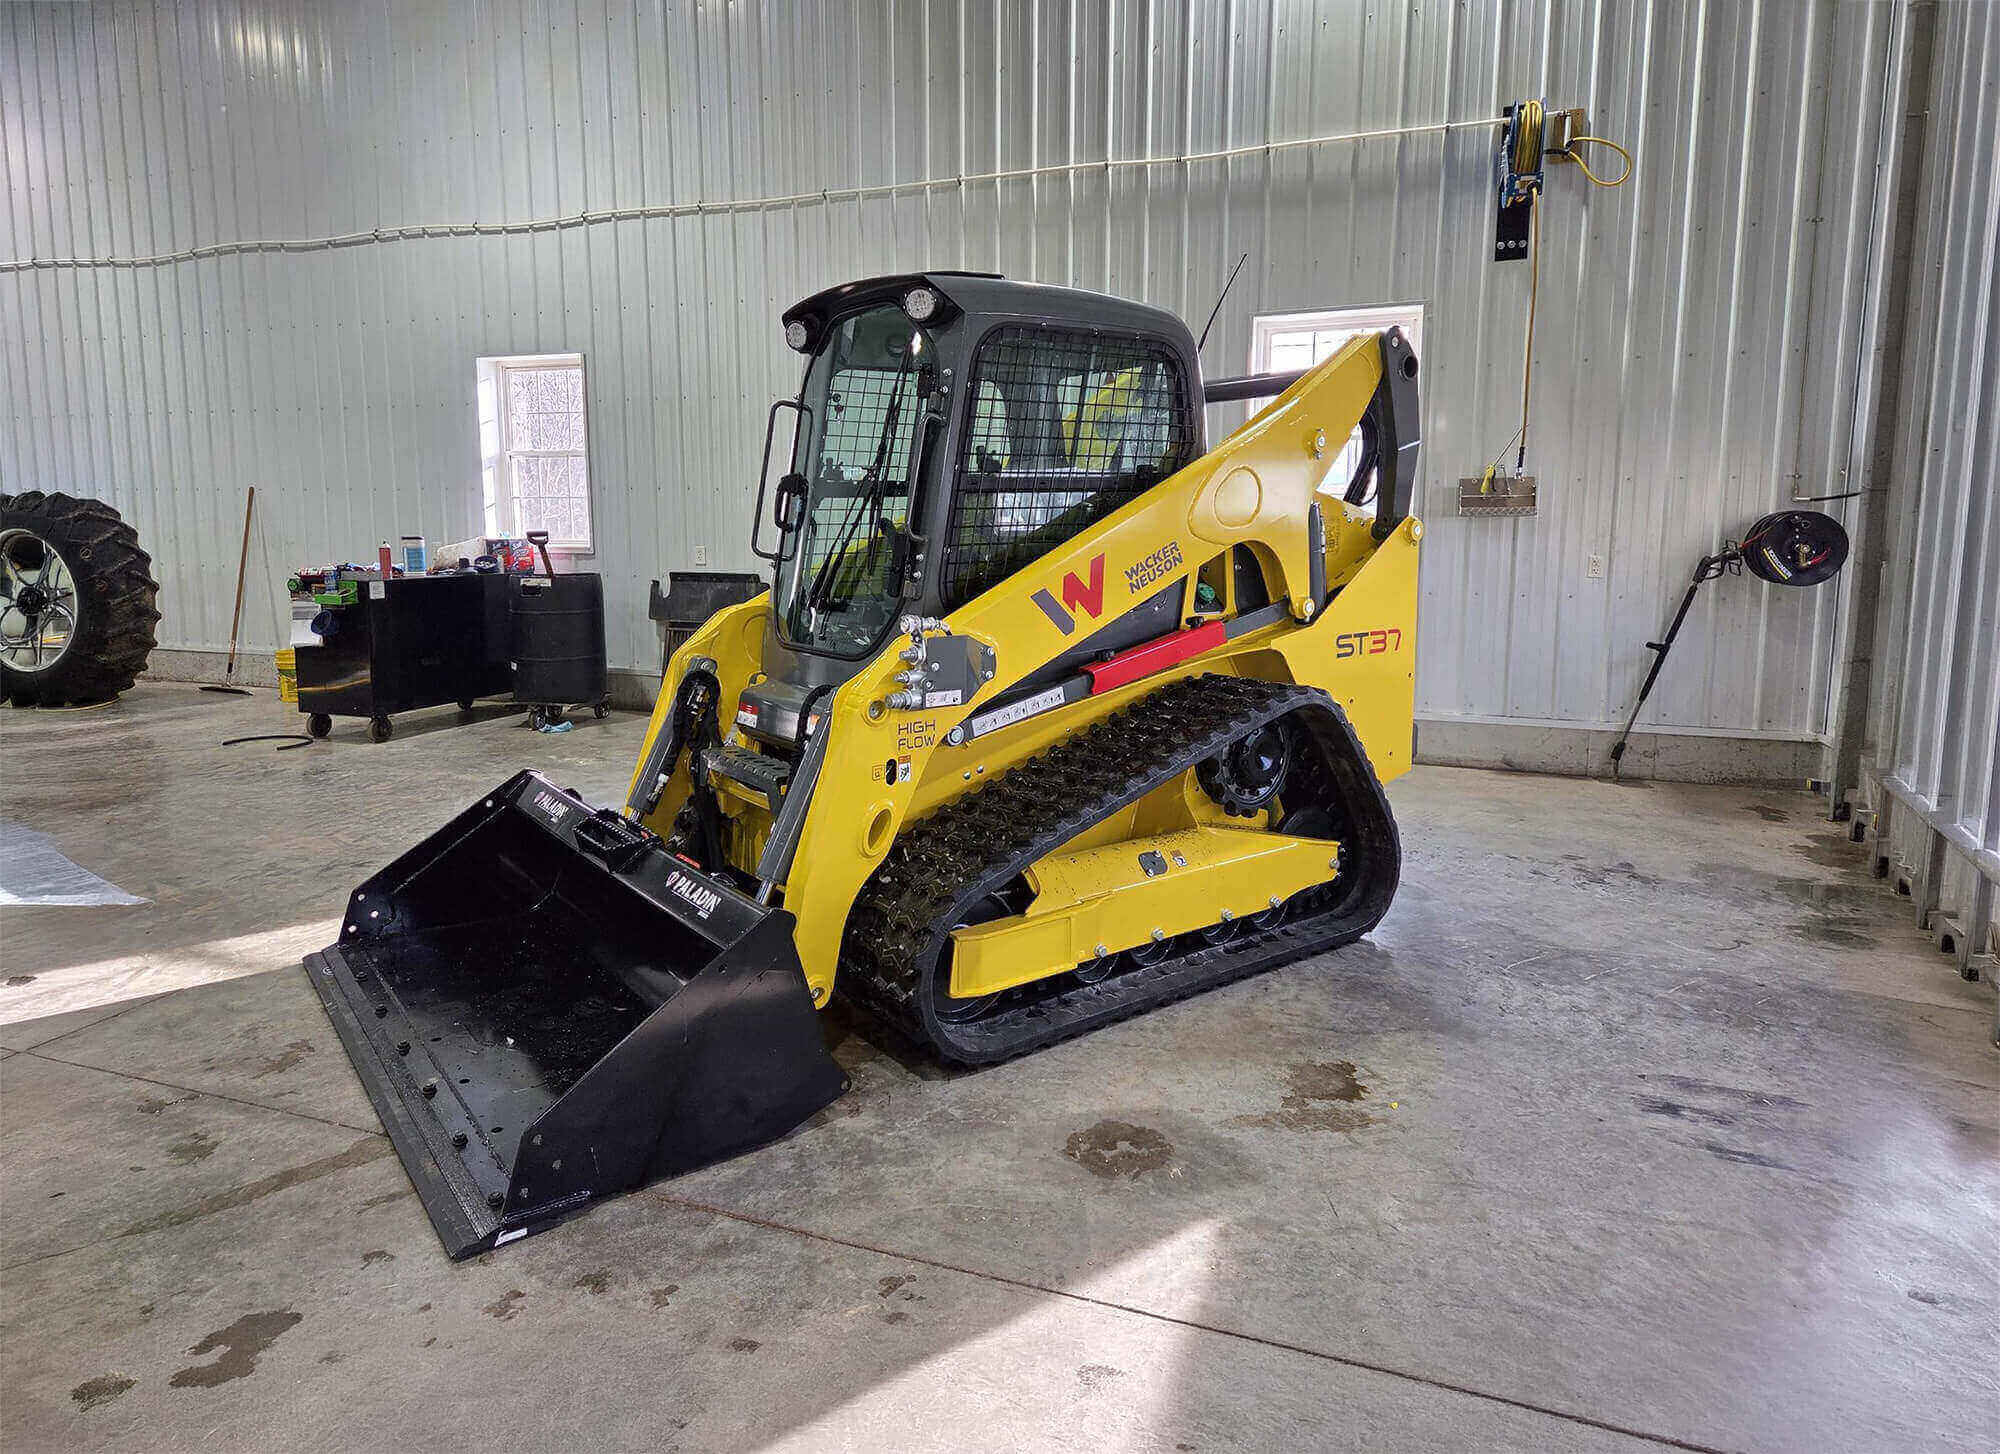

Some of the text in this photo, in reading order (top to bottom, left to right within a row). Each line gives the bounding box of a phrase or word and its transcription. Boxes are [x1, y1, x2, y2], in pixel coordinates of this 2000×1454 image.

[1124, 541, 1179, 581] WACKER
[1129, 552, 1183, 594] NEUSON
[1336, 628, 1401, 658] ST37
[898, 719, 936, 735] HIGH
[898, 734, 936, 751] FLOW
[673, 876, 722, 912] PALADIN
